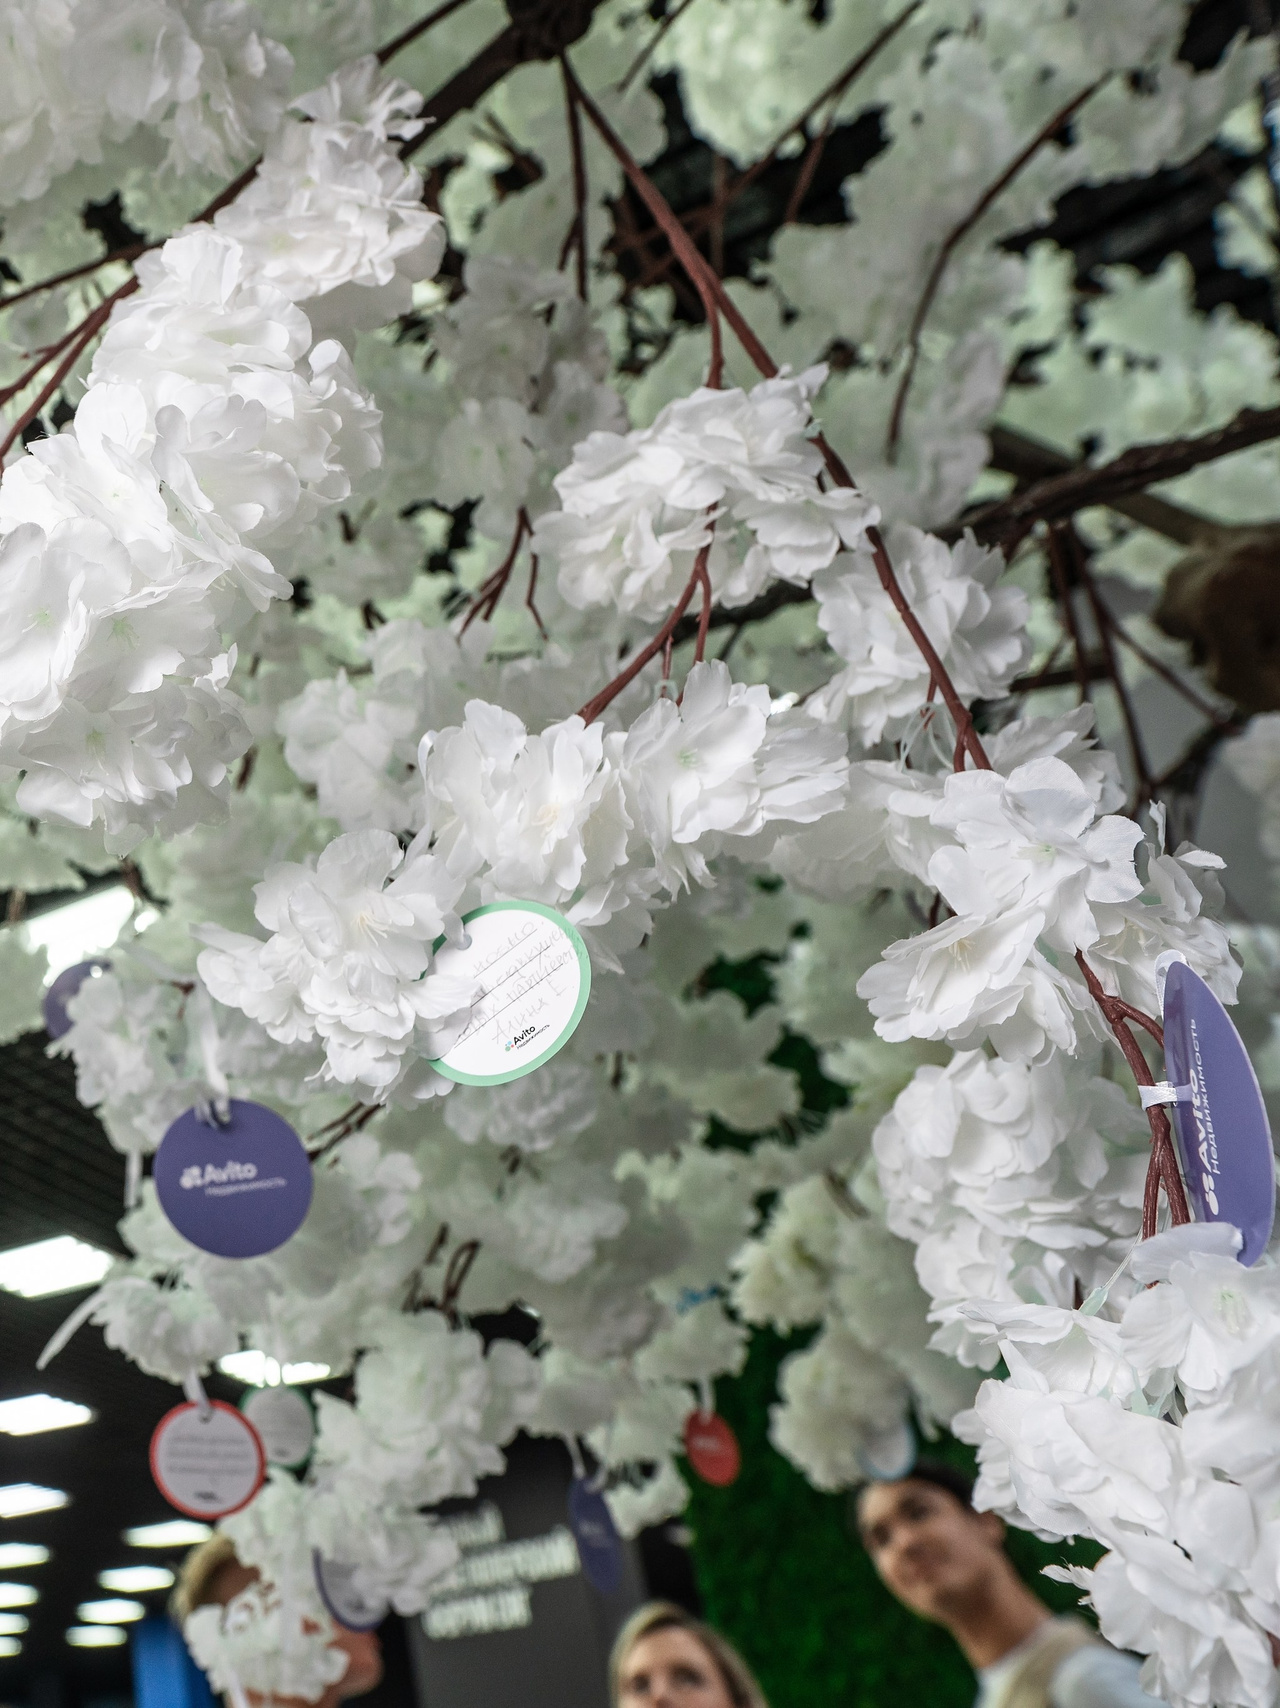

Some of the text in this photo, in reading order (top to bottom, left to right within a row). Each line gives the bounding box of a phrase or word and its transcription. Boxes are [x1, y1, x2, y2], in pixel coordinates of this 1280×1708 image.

[513, 1025, 536, 1045] Avito
[1189, 1069, 1212, 1172] Avito
[1191, 1018, 1221, 1175] Недвижимость
[204, 1161, 259, 1184] Avito
